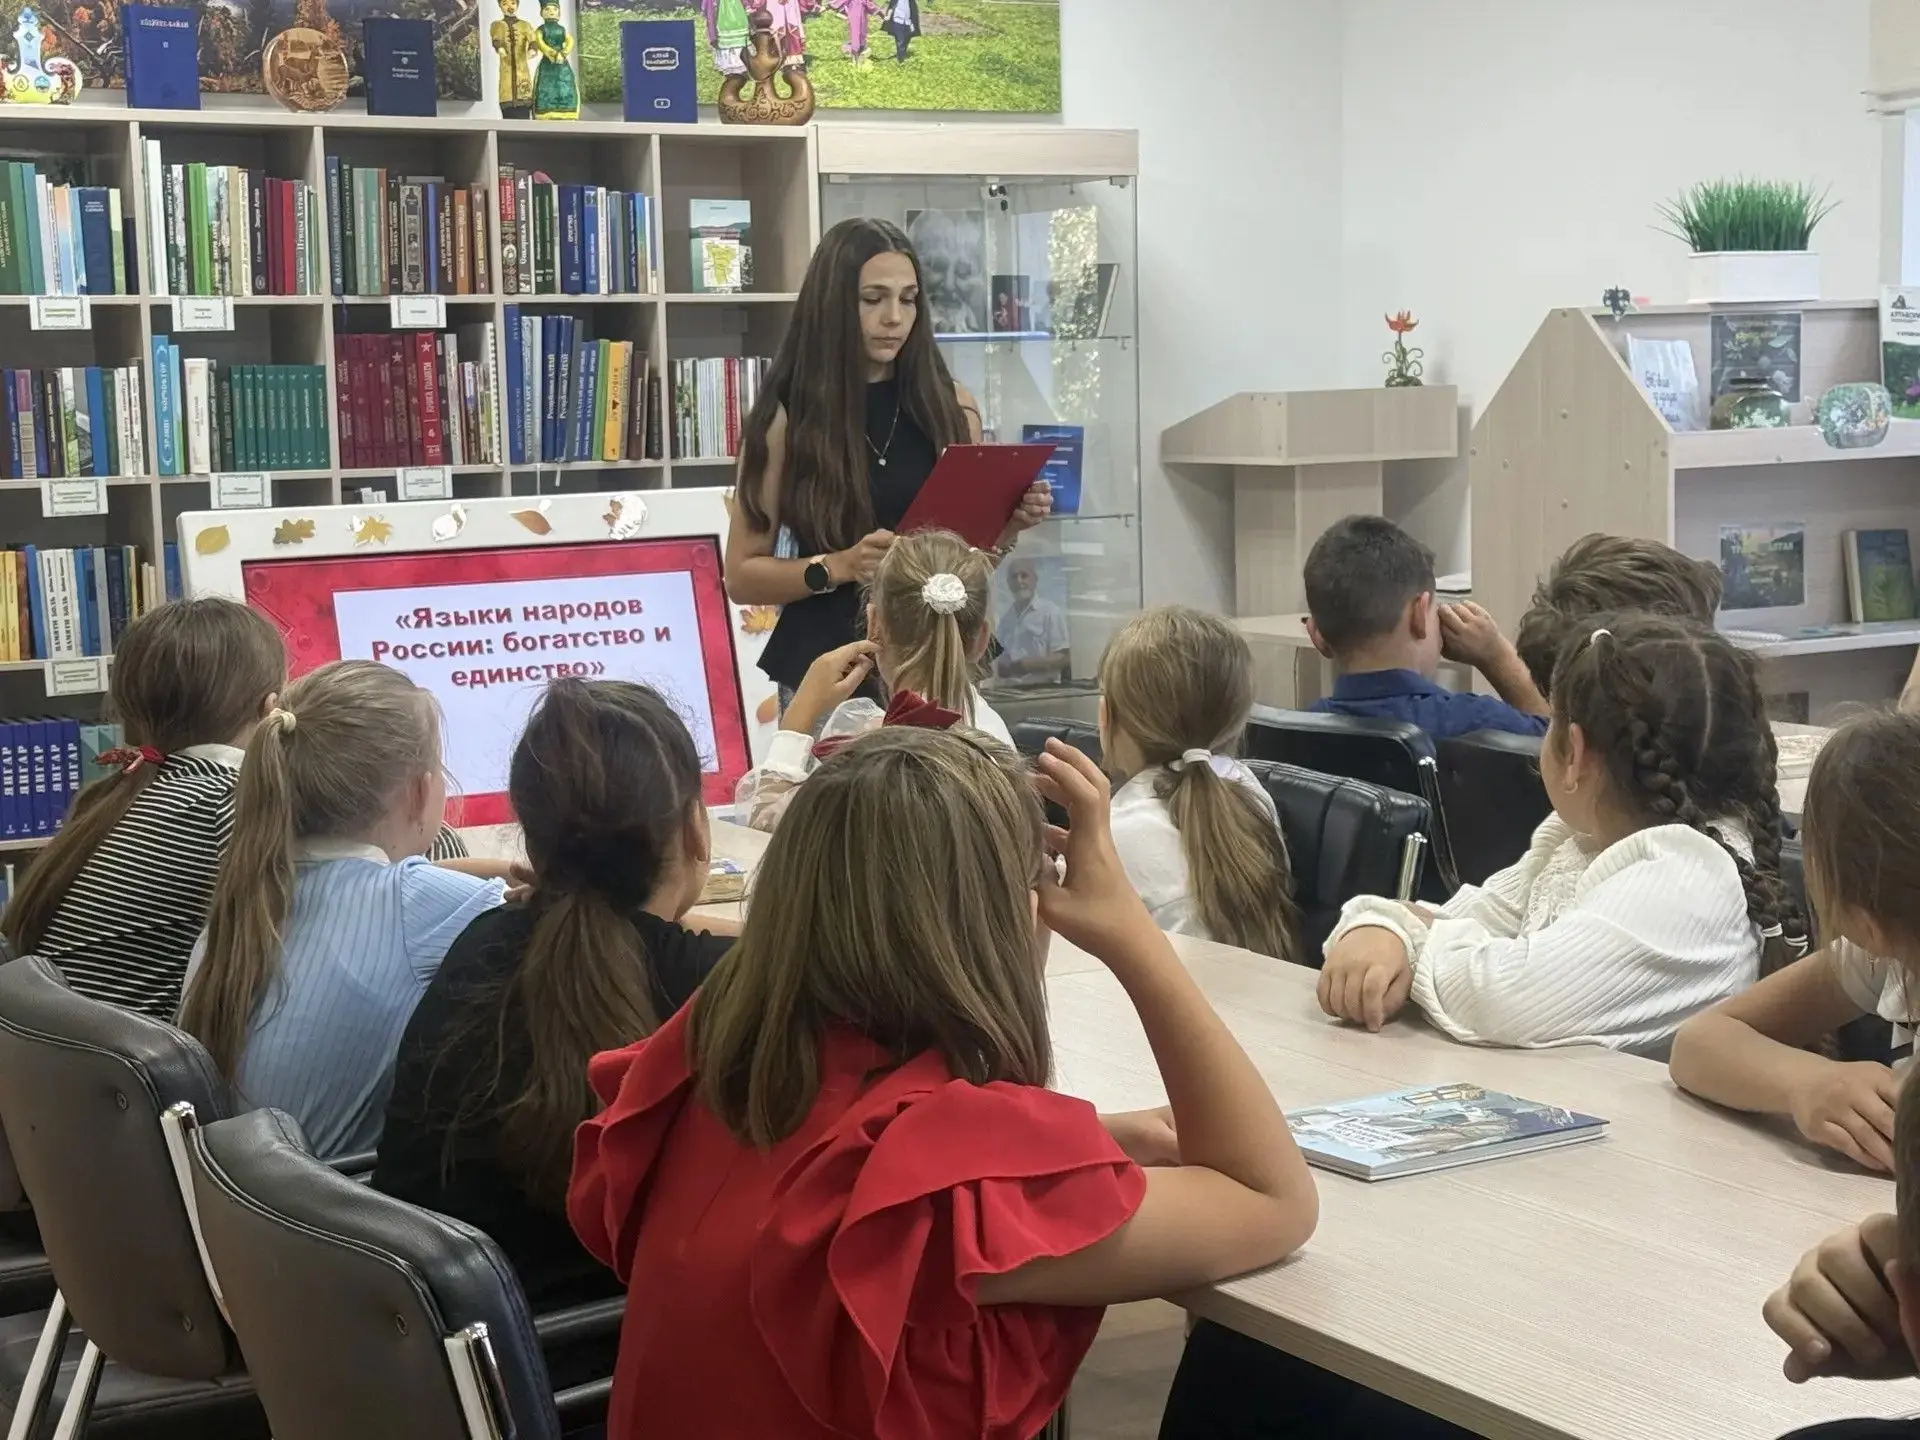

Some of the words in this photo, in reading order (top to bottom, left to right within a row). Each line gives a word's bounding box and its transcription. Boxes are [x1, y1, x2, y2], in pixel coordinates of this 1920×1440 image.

[395, 607, 513, 630] «Языки
[523, 599, 643, 625] народов
[371, 637, 495, 661] России:
[503, 626, 645, 653] богатство
[655, 626, 672, 642] и
[451, 661, 606, 689] единство»
